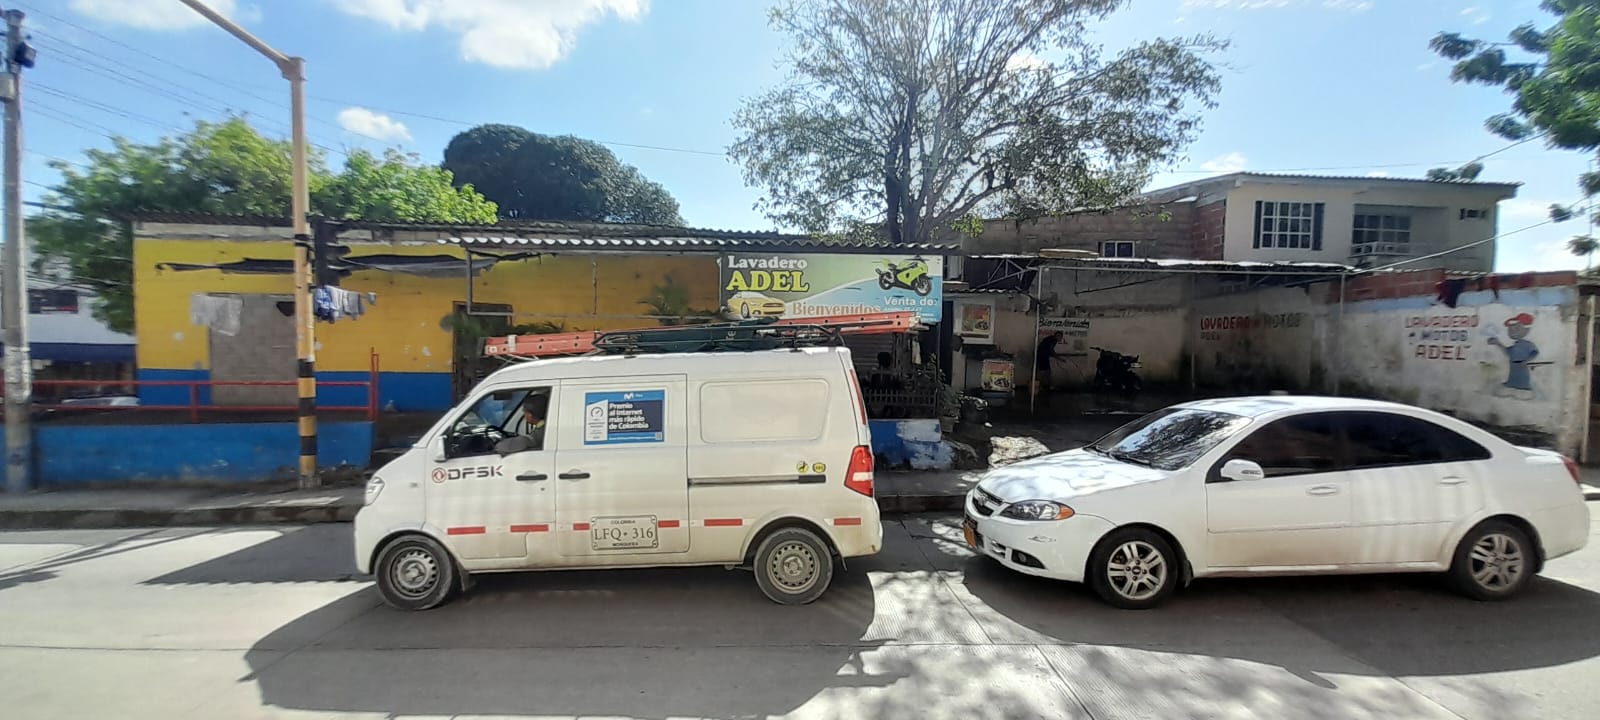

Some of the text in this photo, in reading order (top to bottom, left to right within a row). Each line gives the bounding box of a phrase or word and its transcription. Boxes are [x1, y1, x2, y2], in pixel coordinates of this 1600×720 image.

[728, 256, 808, 269] Lavadero
[726, 270, 809, 292] ADEL
[884, 296, 917, 306] Venta
[792, 302, 881, 316] Bienvenidos
[618, 422, 649, 430] Colombia
[624, 416, 645, 424] rápido
[447, 465, 504, 480] DFSK
[594, 527, 654, 541] LFQ 316
